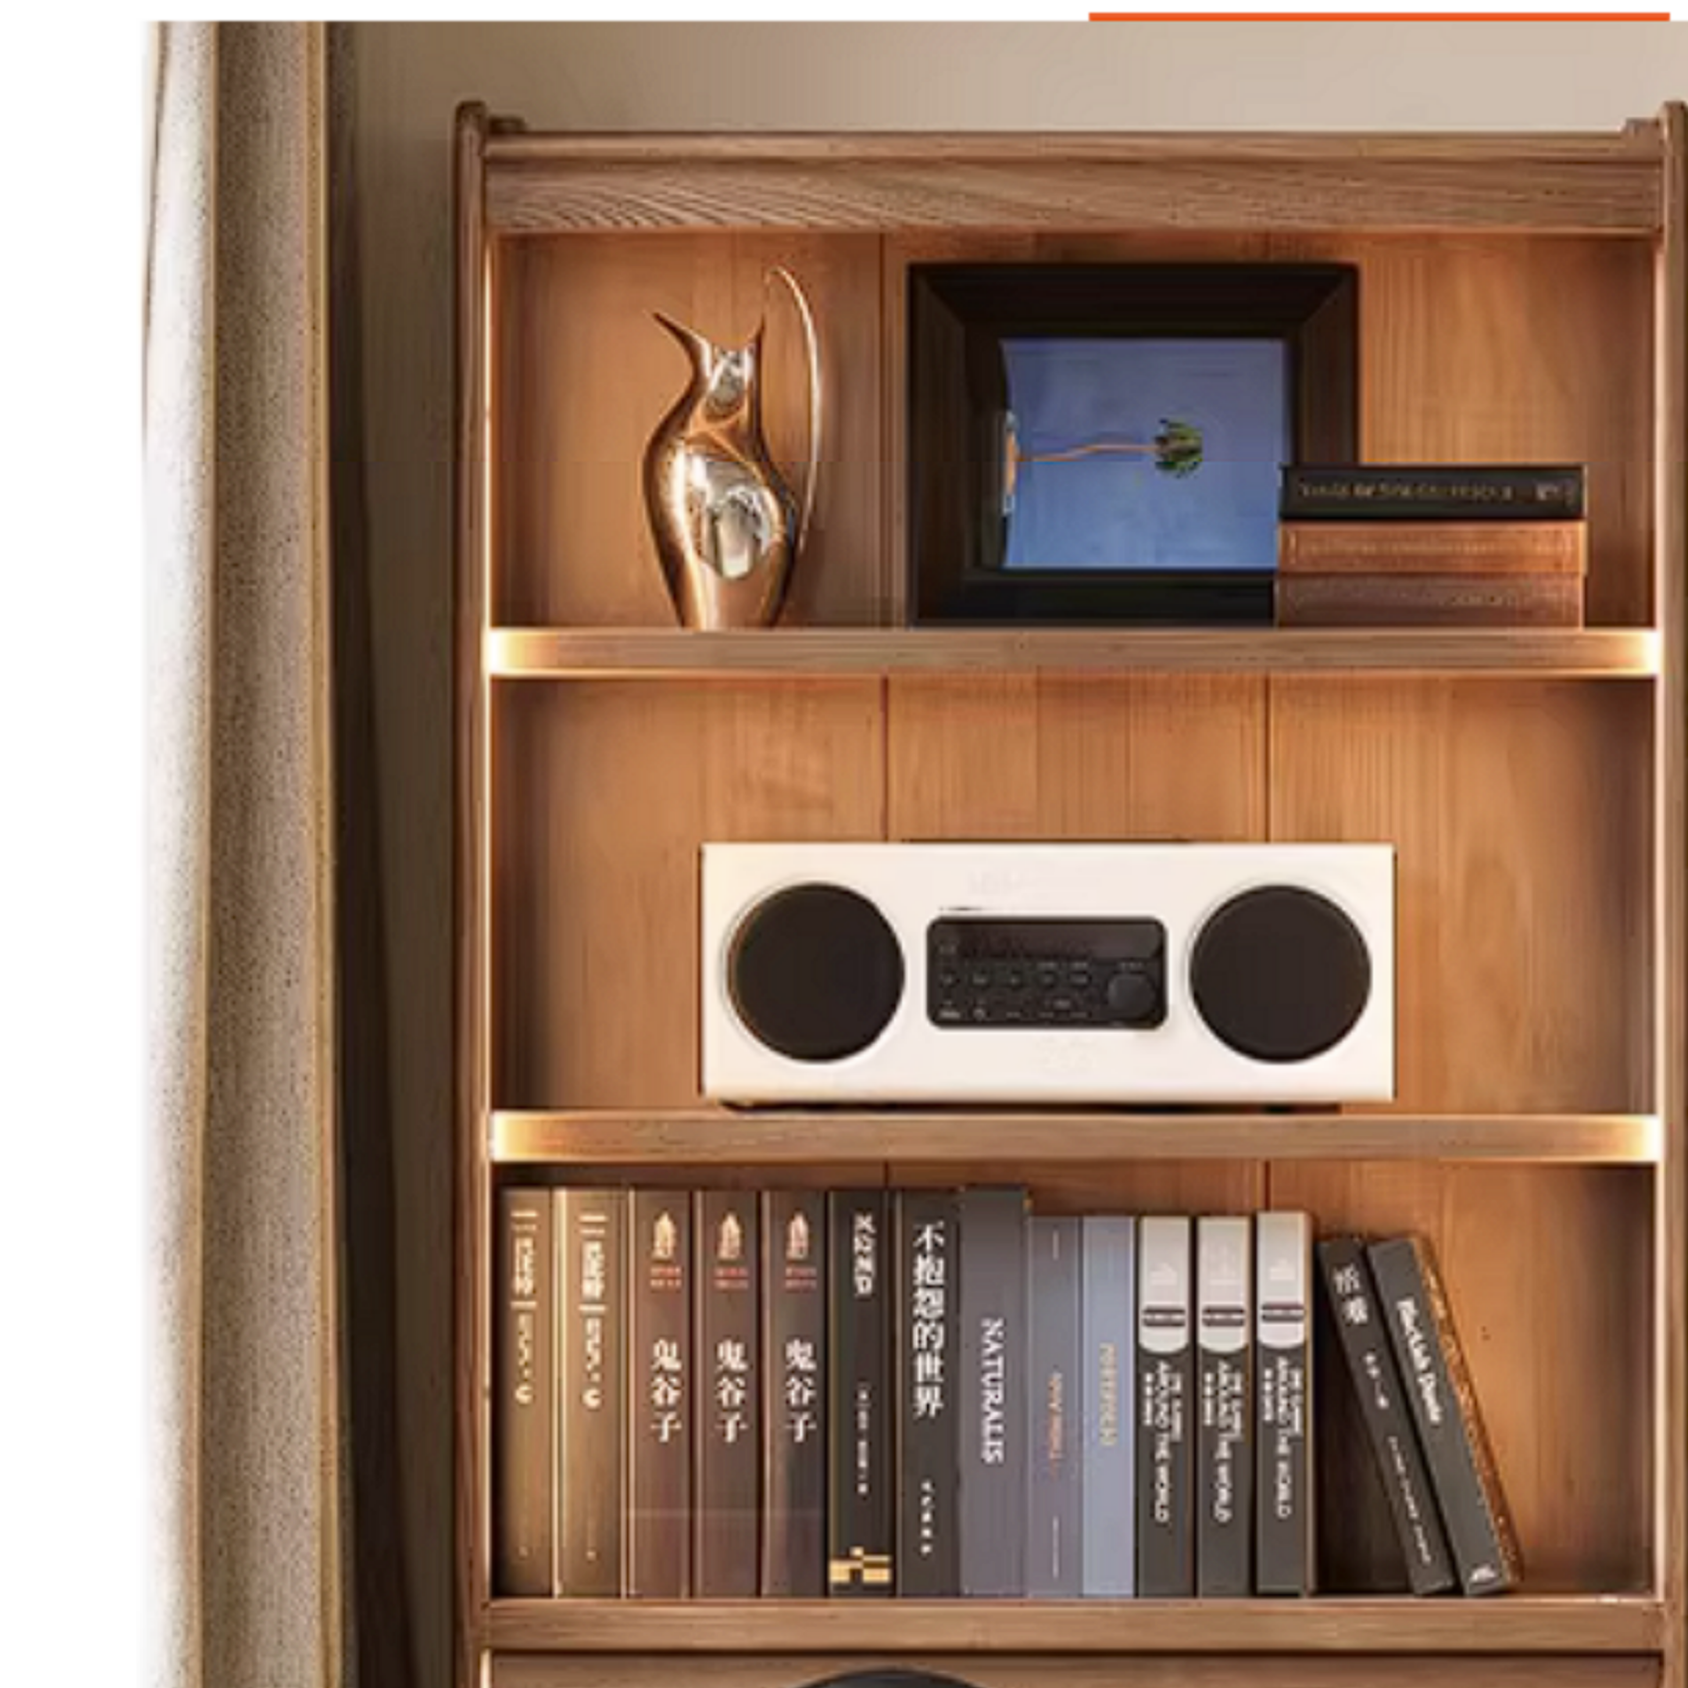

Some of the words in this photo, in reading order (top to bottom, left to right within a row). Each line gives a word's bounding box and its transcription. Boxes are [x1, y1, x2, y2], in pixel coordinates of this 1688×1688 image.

[911, 1219, 945, 1418] 不抱怨的世界
[650, 1338, 683, 1443] 鬼谷子
[715, 1338, 748, 1443] 鬼谷子
[785, 1338, 817, 1443] 鬼谷子
[979, 1317, 1005, 1464] NATURALIS
